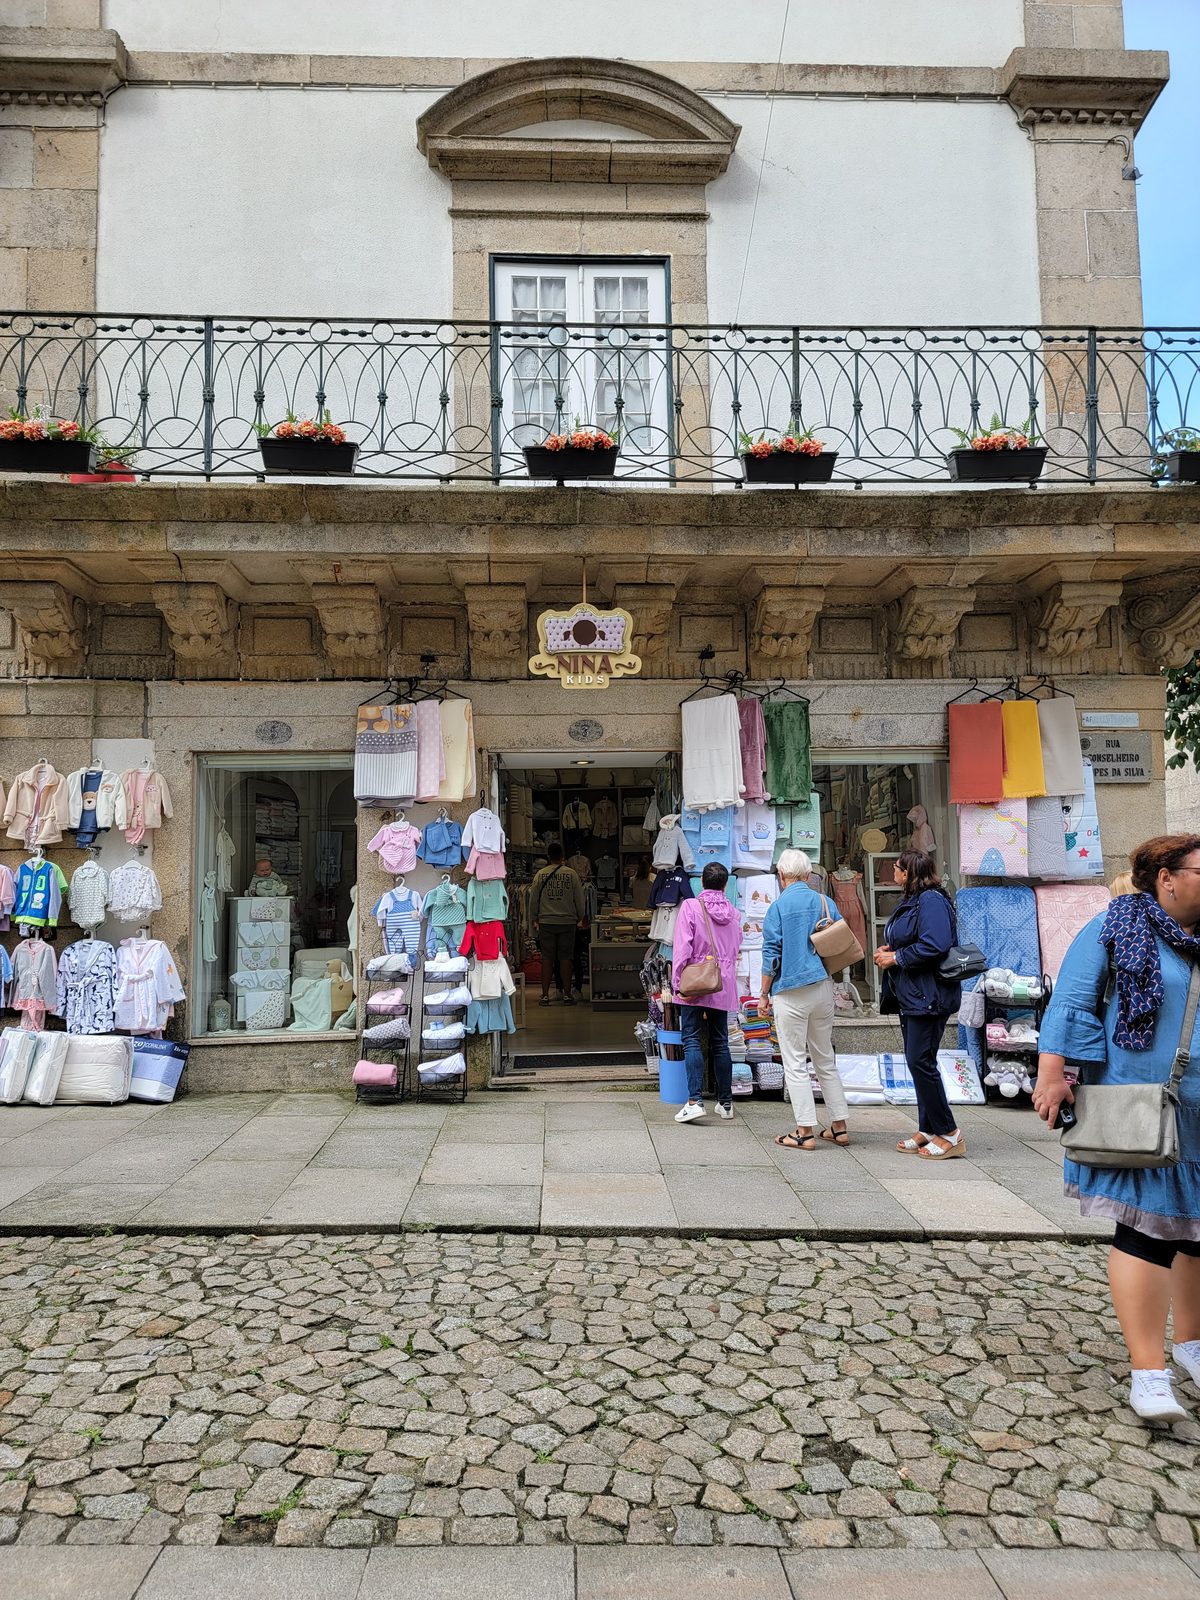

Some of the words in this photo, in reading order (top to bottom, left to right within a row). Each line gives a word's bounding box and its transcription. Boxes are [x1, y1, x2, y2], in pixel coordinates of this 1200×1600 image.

[555, 655, 613, 674] NINA
[566, 675, 605, 685] KIDS
[580, 724, 590, 738] 3
[1105, 739, 1121, 749] RUA
[1088, 753, 1140, 763] CONSELHEIRO
[1093, 767, 1109, 777] PES
[1112, 767, 1121, 777] DA
[1124, 767, 1145, 777] SILVA
[547, 889, 564, 897] CLUB
